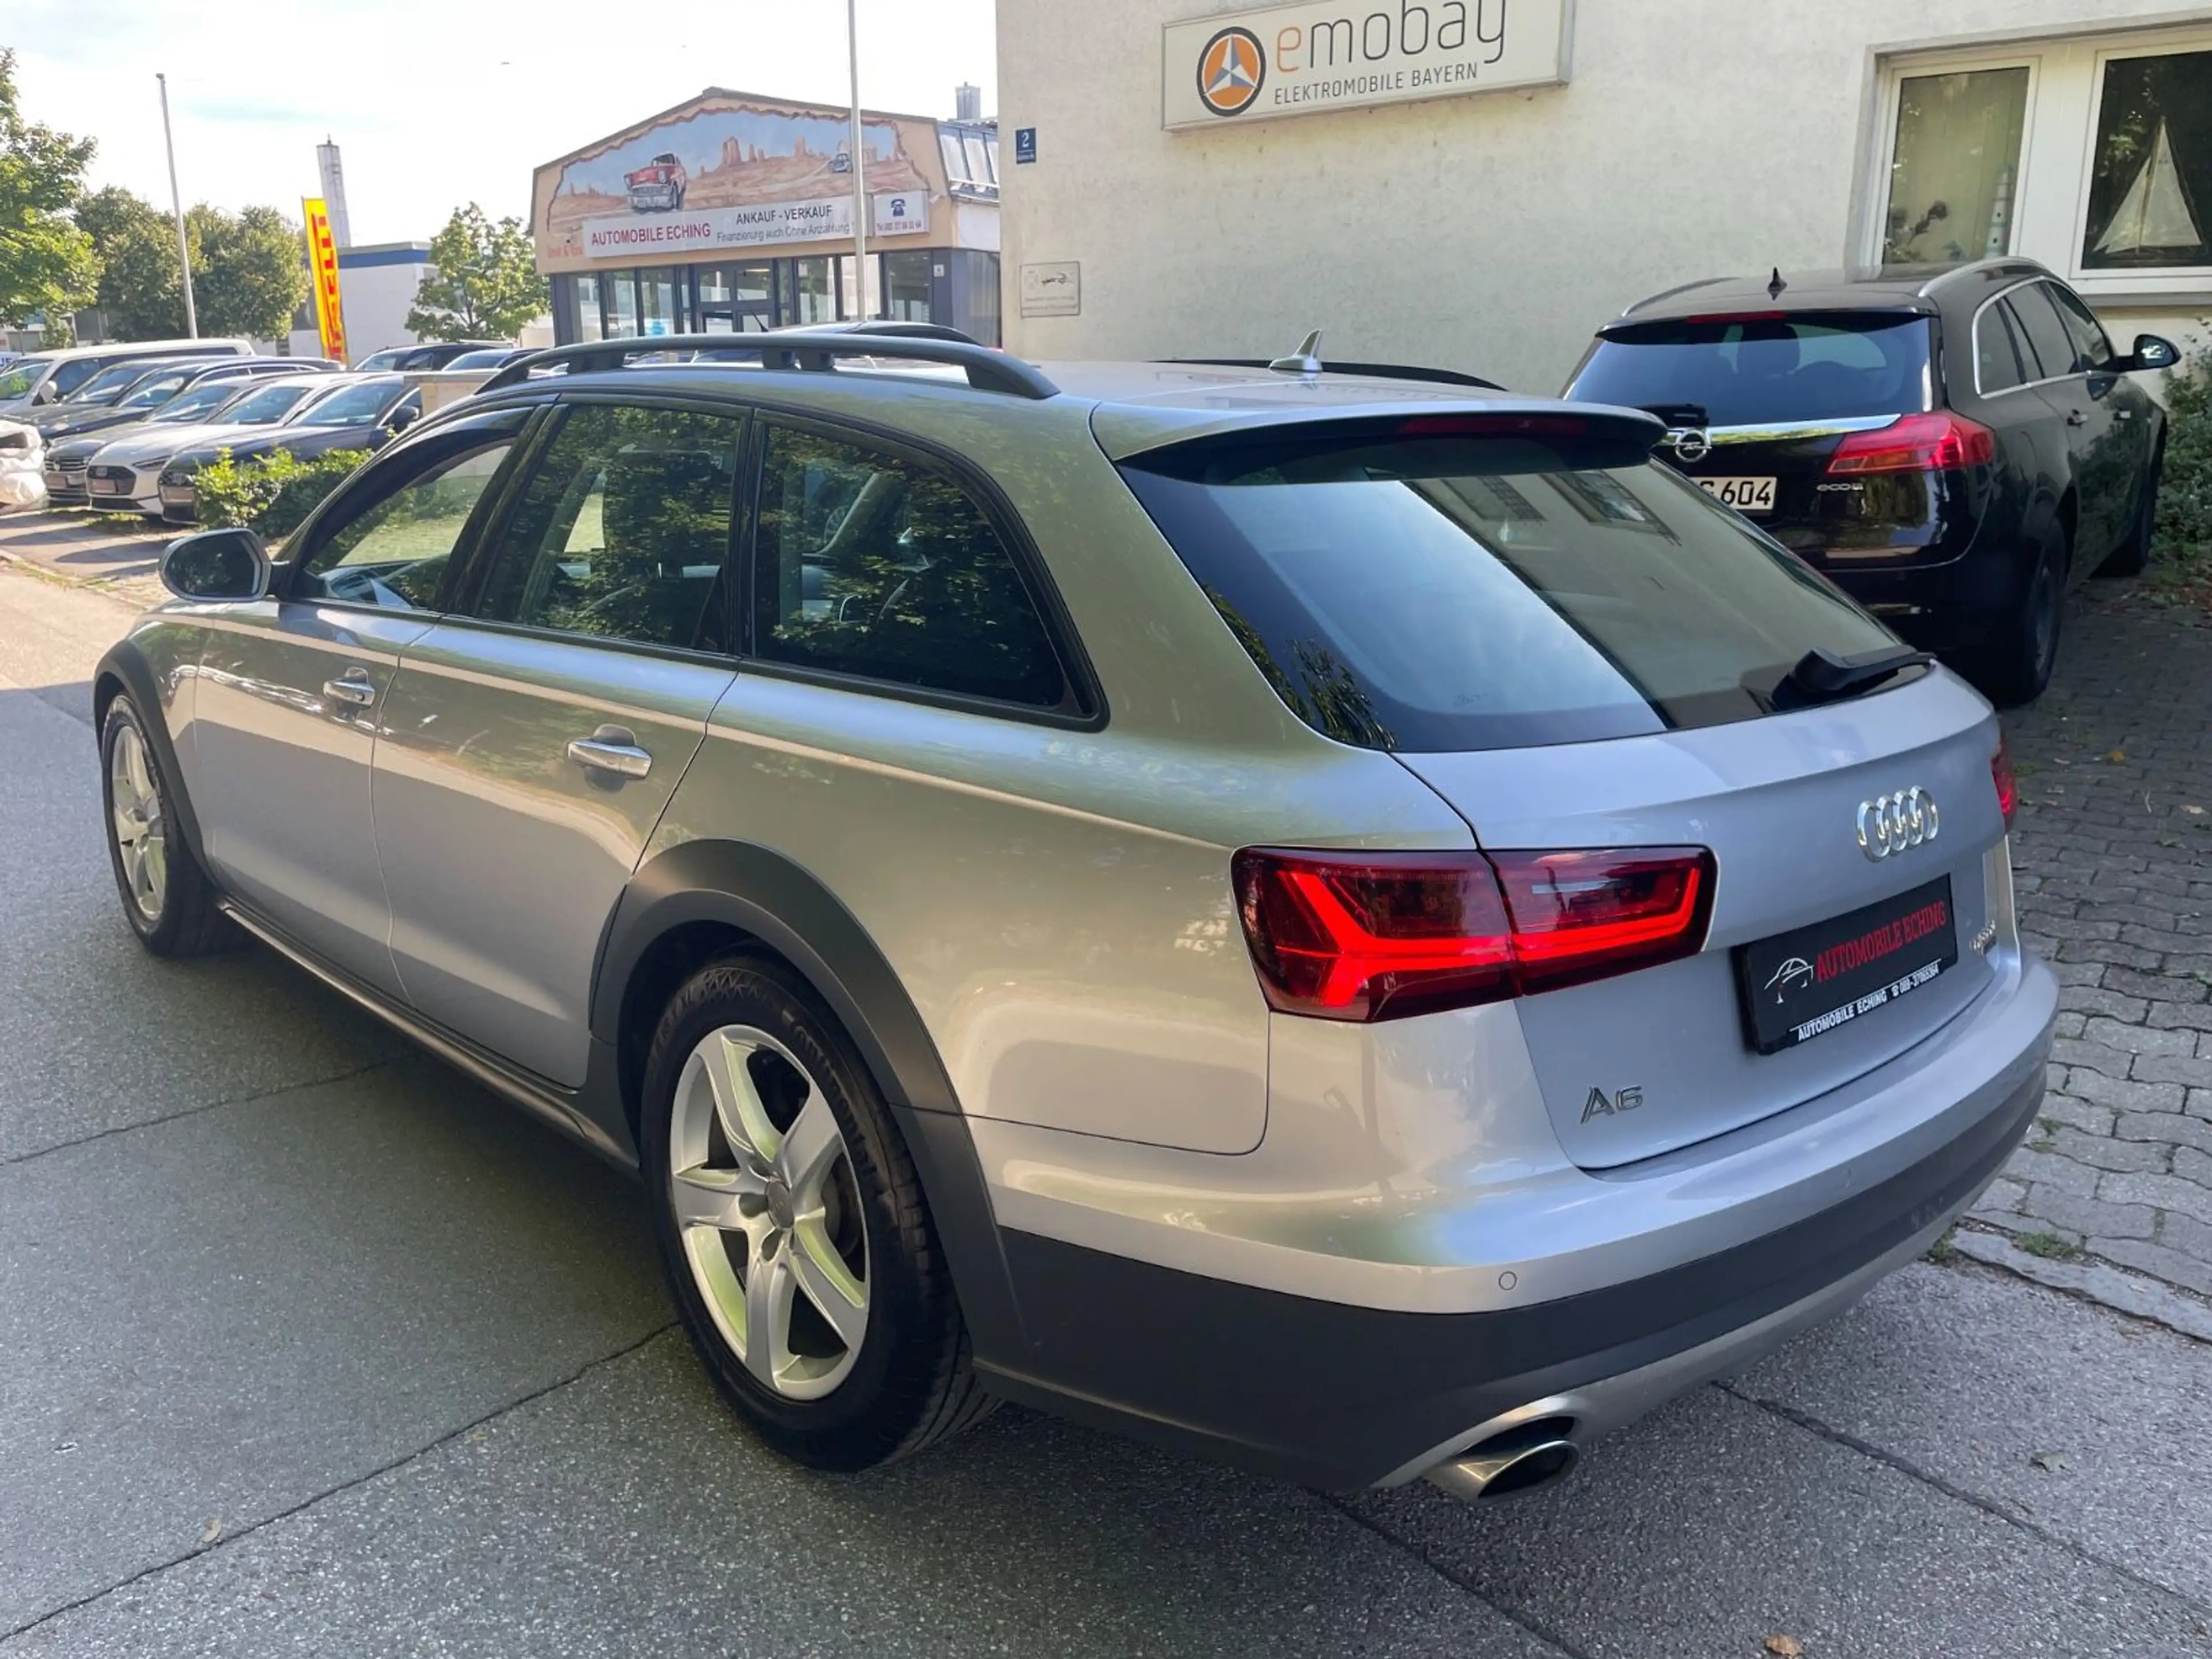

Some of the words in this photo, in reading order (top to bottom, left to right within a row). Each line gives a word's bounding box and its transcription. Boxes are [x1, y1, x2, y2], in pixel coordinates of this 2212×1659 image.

[1277, 0, 1505, 73] emobay
[1274, 71, 1404, 105] ELEKTROMOBILE
[1411, 62, 1478, 87] BAYERN
[1021, 132, 1030, 147] 2
[736, 209, 777, 225] ANKAUF
[783, 204, 832, 221] VERKAUF
[591, 226, 664, 246] AUTOMOBILE
[666, 222, 711, 240] ECHING
[1721, 480, 1771, 506] 604
[1816, 921, 1903, 983] AUTOMOBILE
[1901, 898, 1946, 945] ECHING
[1798, 1005, 1855, 1041] AUTOMOBILE
[1857, 988, 1888, 1014] ECHING
[1580, 1086, 1643, 1124] A6
